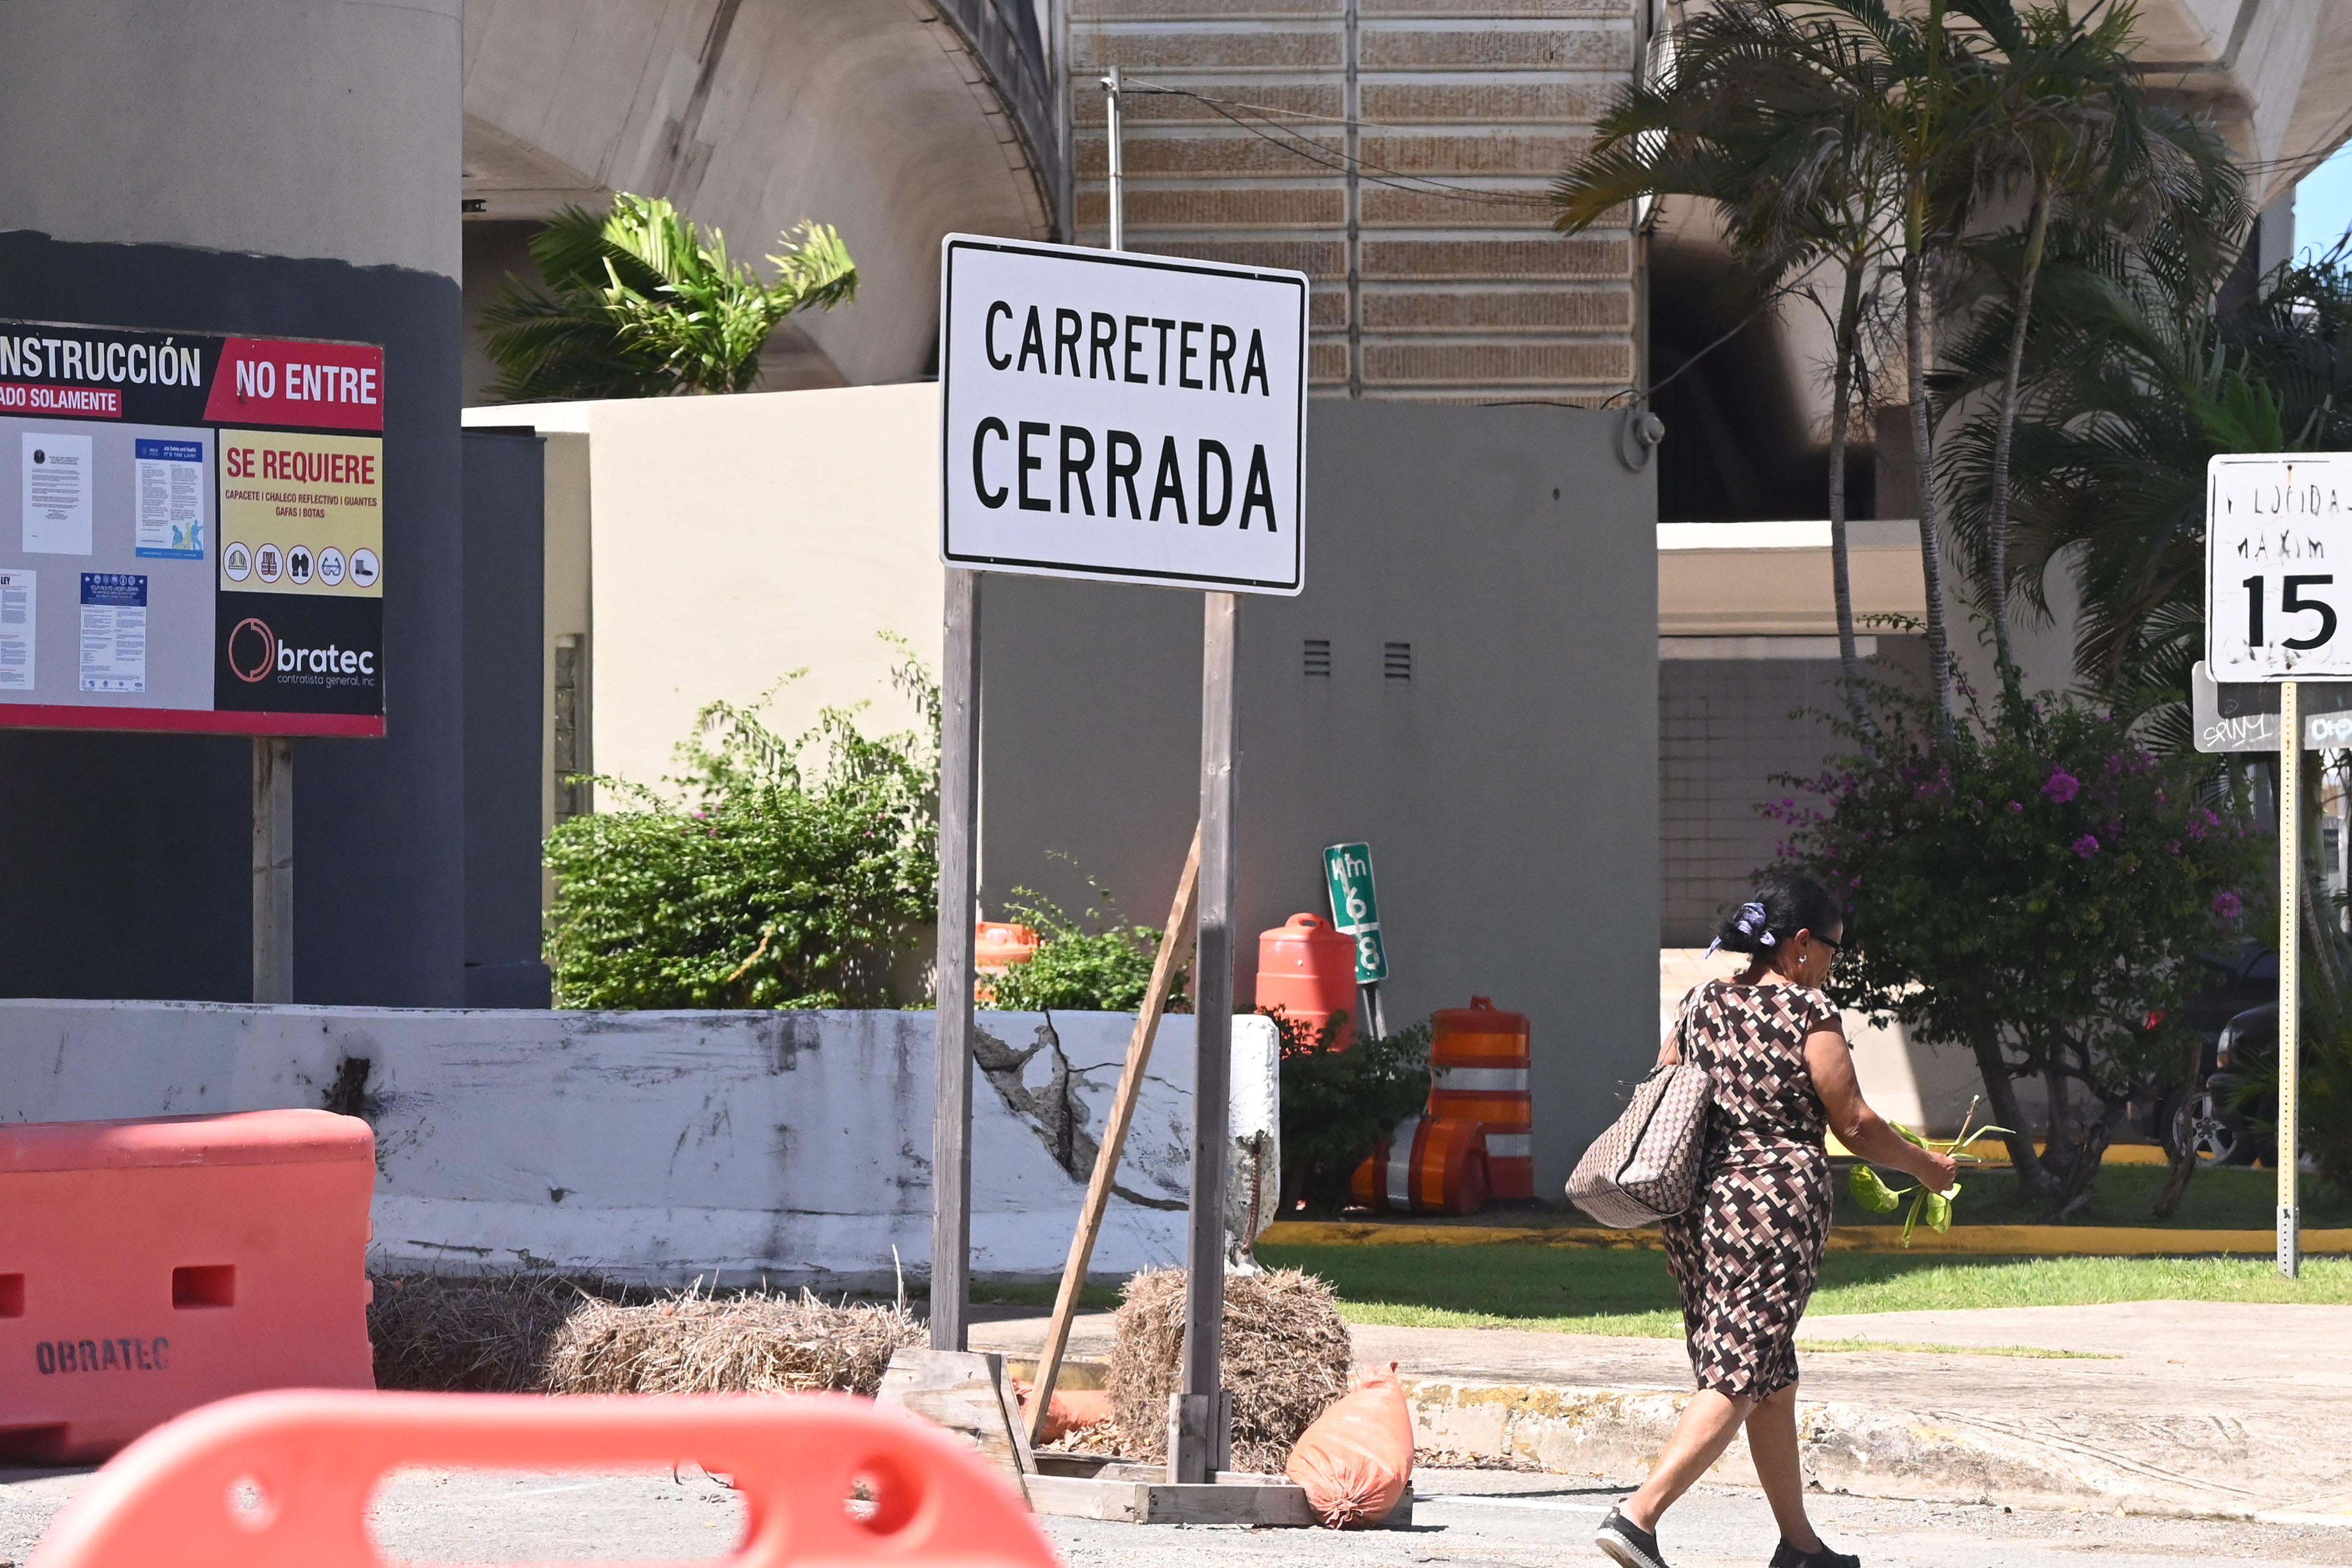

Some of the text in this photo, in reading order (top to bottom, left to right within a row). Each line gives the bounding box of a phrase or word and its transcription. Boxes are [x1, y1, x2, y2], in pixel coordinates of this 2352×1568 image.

[0, 335, 200, 387] NSTRUCCIÓN
[985, 301, 1270, 397] CARRETERA
[30, 388, 117, 412] SOLAMENTE
[236, 359, 377, 404] NO ENTRE
[227, 447, 375, 485] SE REQUIERE
[972, 416, 1278, 532] CERRADA
[225, 489, 260, 501] CAPACETE
[265, 492, 296, 503] CHALECO
[298, 494, 339, 505] REFLECTIVO
[344, 496, 377, 507] GUANTES
[276, 506, 298, 517] GAFAS
[303, 508, 325, 518] BOTAS
[2242, 574, 2337, 651] 15
[277, 674, 375, 689] contratista general, inc
[1345, 886, 1368, 919] 6
[1359, 936, 1381, 970] 8
[36, 1336, 169, 1375] OBRATEC
